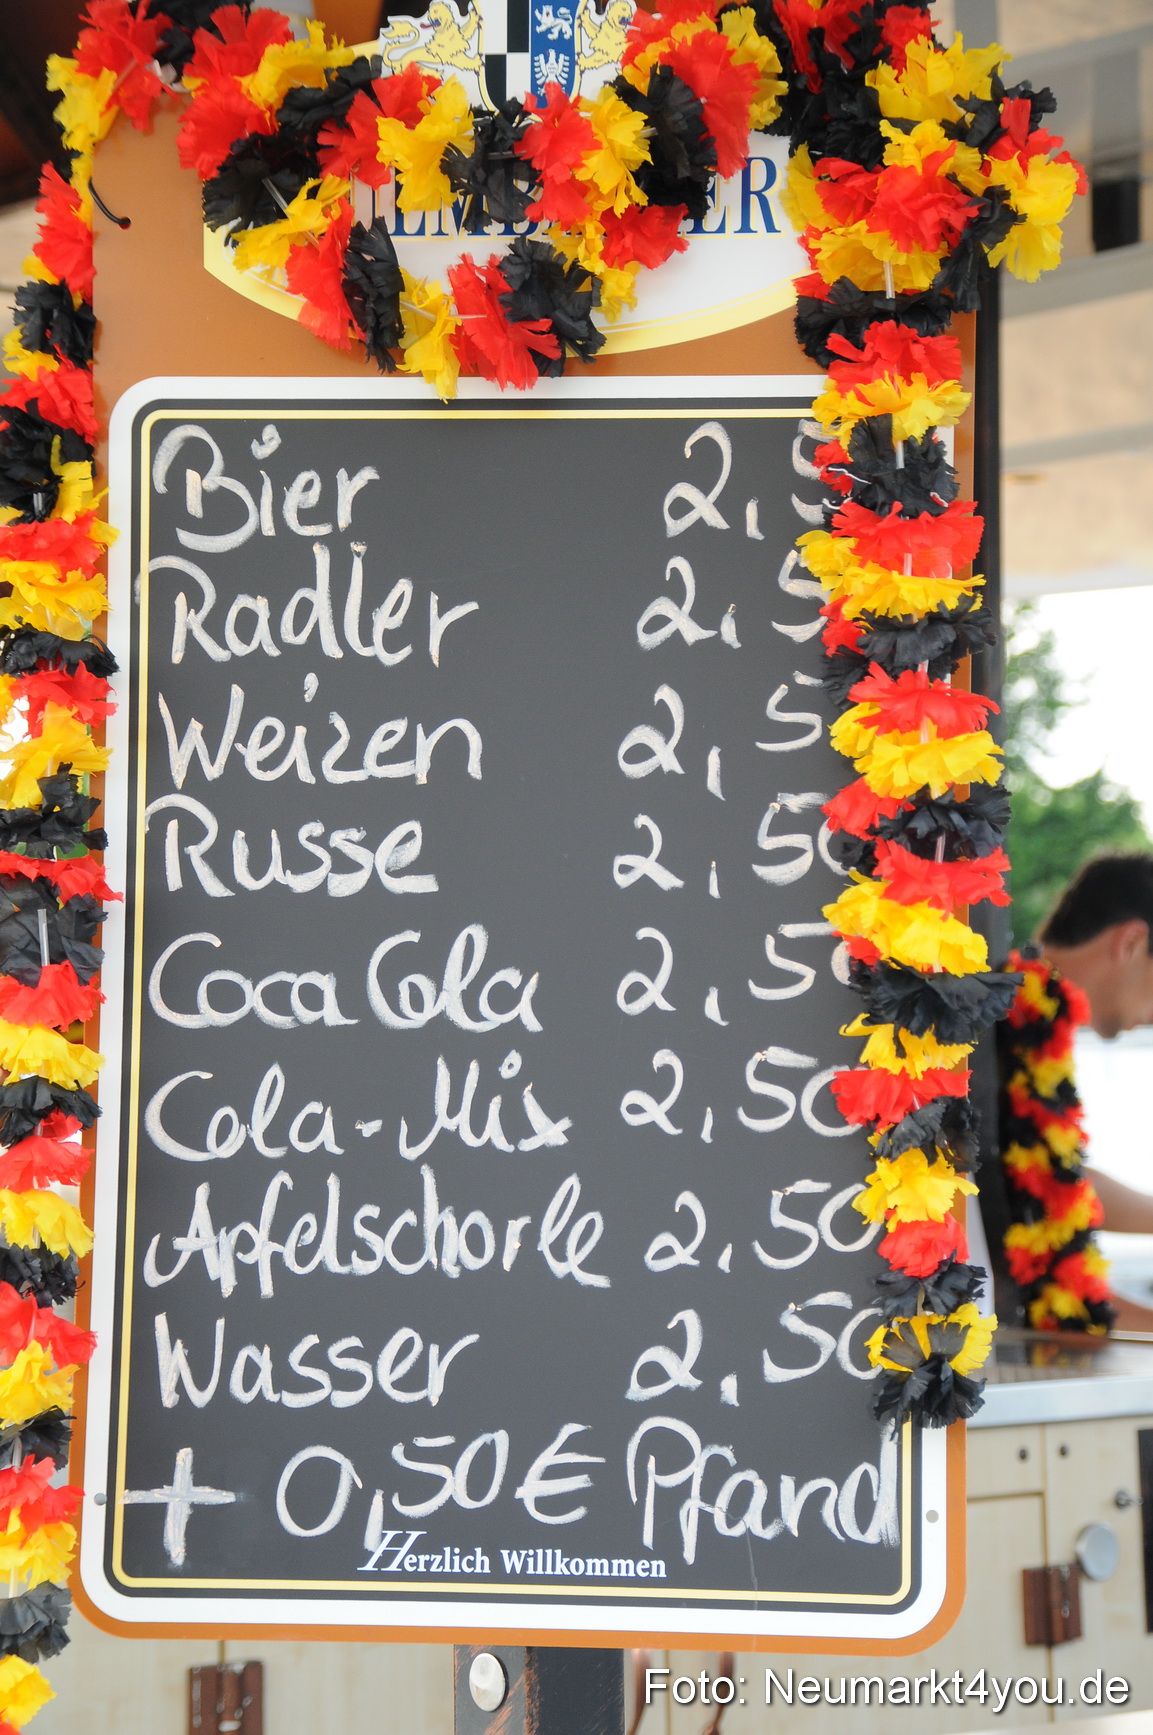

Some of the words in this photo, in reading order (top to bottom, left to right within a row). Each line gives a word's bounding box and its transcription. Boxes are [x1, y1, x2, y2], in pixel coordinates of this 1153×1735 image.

[153, 424, 380, 552] Bier
[663, 419, 842, 540] 2,5
[135, 541, 479, 668] Radler
[637, 548, 829, 651] 2,5
[158, 672, 482, 790] Weizen
[617, 670, 824, 801] 2,5
[144, 793, 439, 898] Russe
[148, 931, 359, 1029] Coca
[366, 923, 543, 1033] Cola
[616, 922, 852, 1027] 2,5
[143, 1164, 612, 1299] Apfelschorle
[643, 1179, 884, 1274] 2,50
[154, 1312, 480, 1408] Wasser
[625, 1291, 884, 1408] 2,50
[356, 1529, 492, 1574] Herzlich
[500, 1548, 668, 1578] Willkommen
[627, 1416, 899, 1565] Pfand
